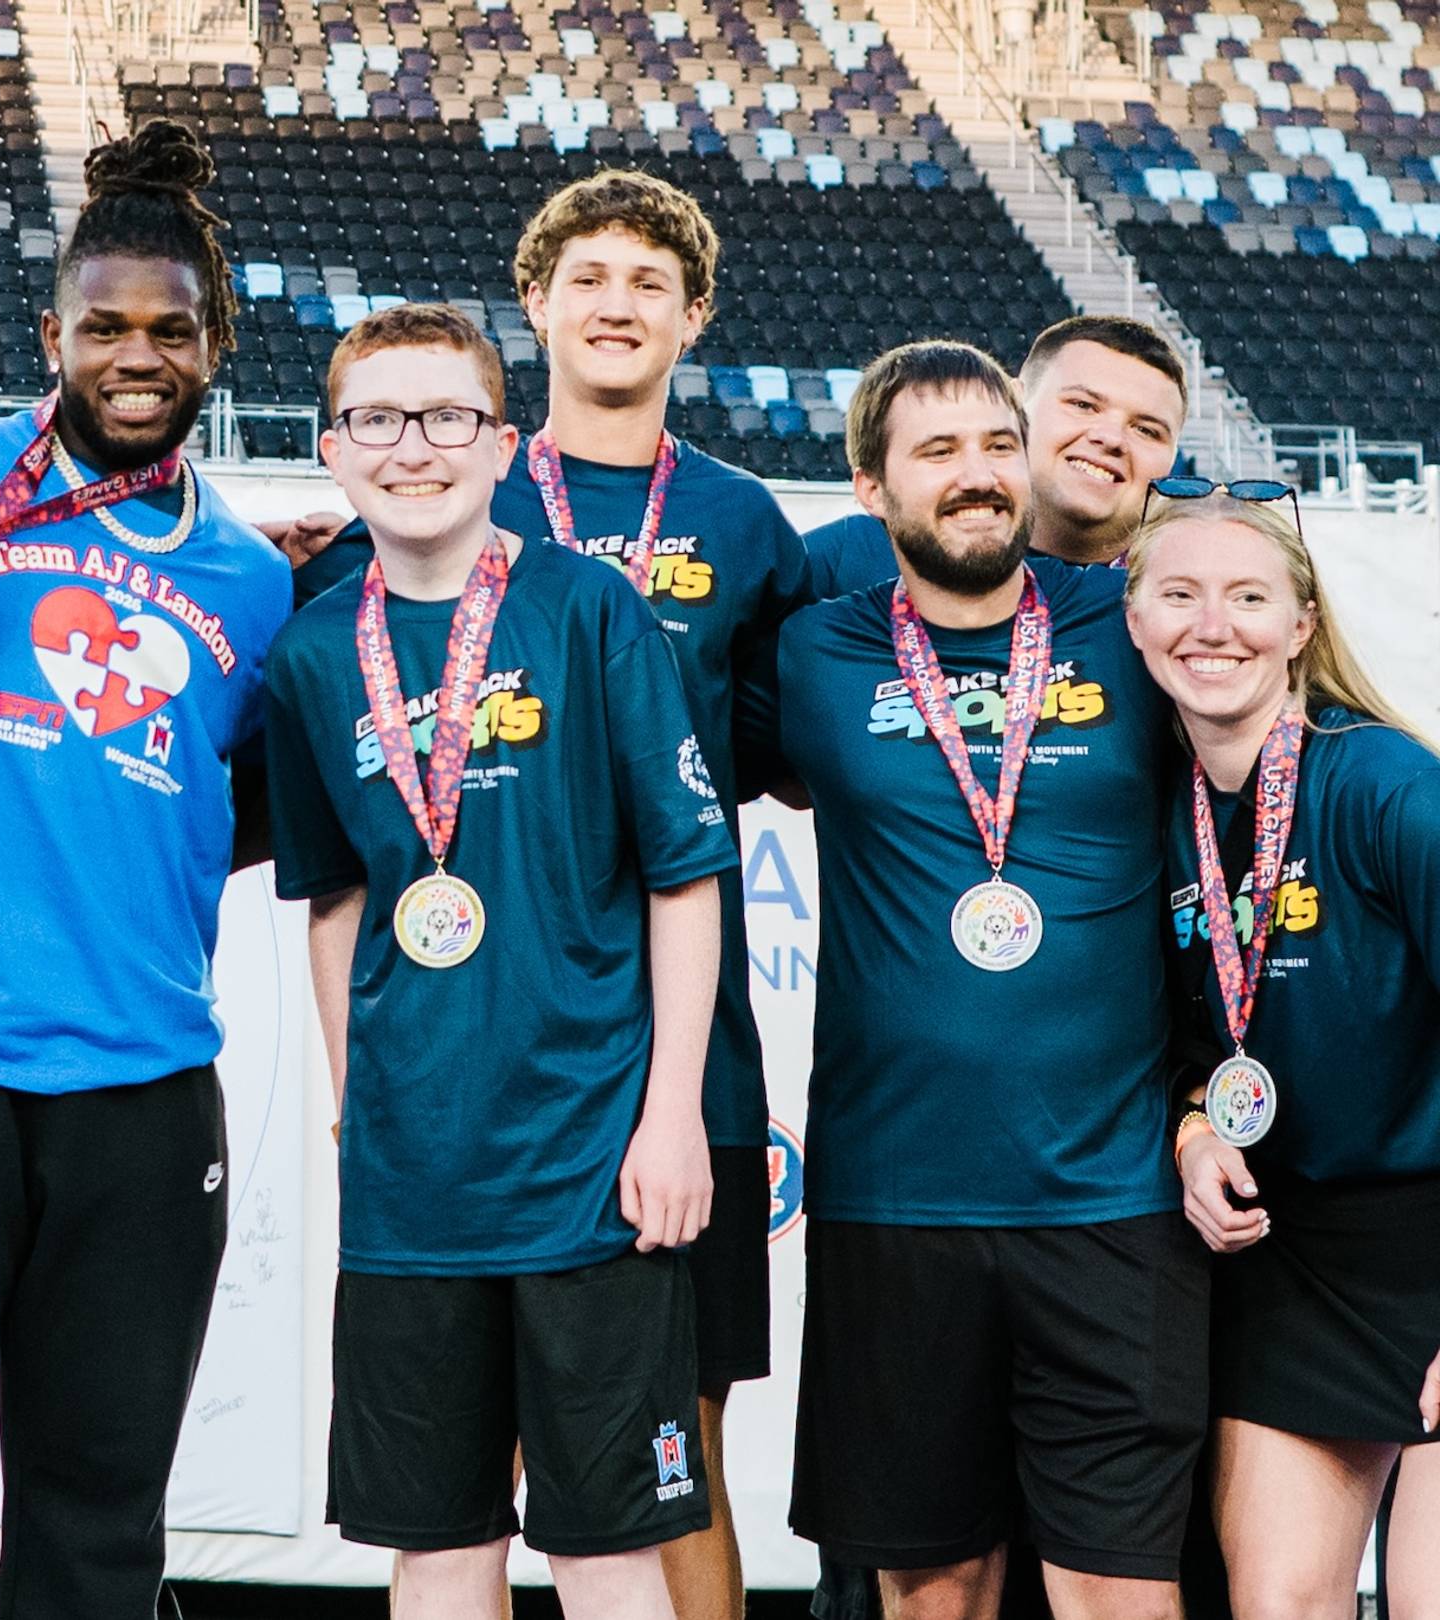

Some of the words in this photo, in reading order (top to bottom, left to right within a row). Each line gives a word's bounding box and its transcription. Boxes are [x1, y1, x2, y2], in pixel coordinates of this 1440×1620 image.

[81, 545, 129, 585] AJ
[129, 563, 153, 599] &
[154, 574, 238, 677] Landon
[903, 621, 920, 652] 2026
[1019, 612, 1038, 649] USA
[367, 634, 395, 729] MINNESOTA
[448, 622, 480, 722] MINNESOTA
[469, 586, 492, 619] 2026
[1011, 654, 1034, 722] GAMES
[910, 652, 949, 736] MINNESOTA
[1035, 745, 1089, 756] MOVEMENT
[1264, 765, 1282, 809] USA
[1261, 814, 1280, 889] GAMES
